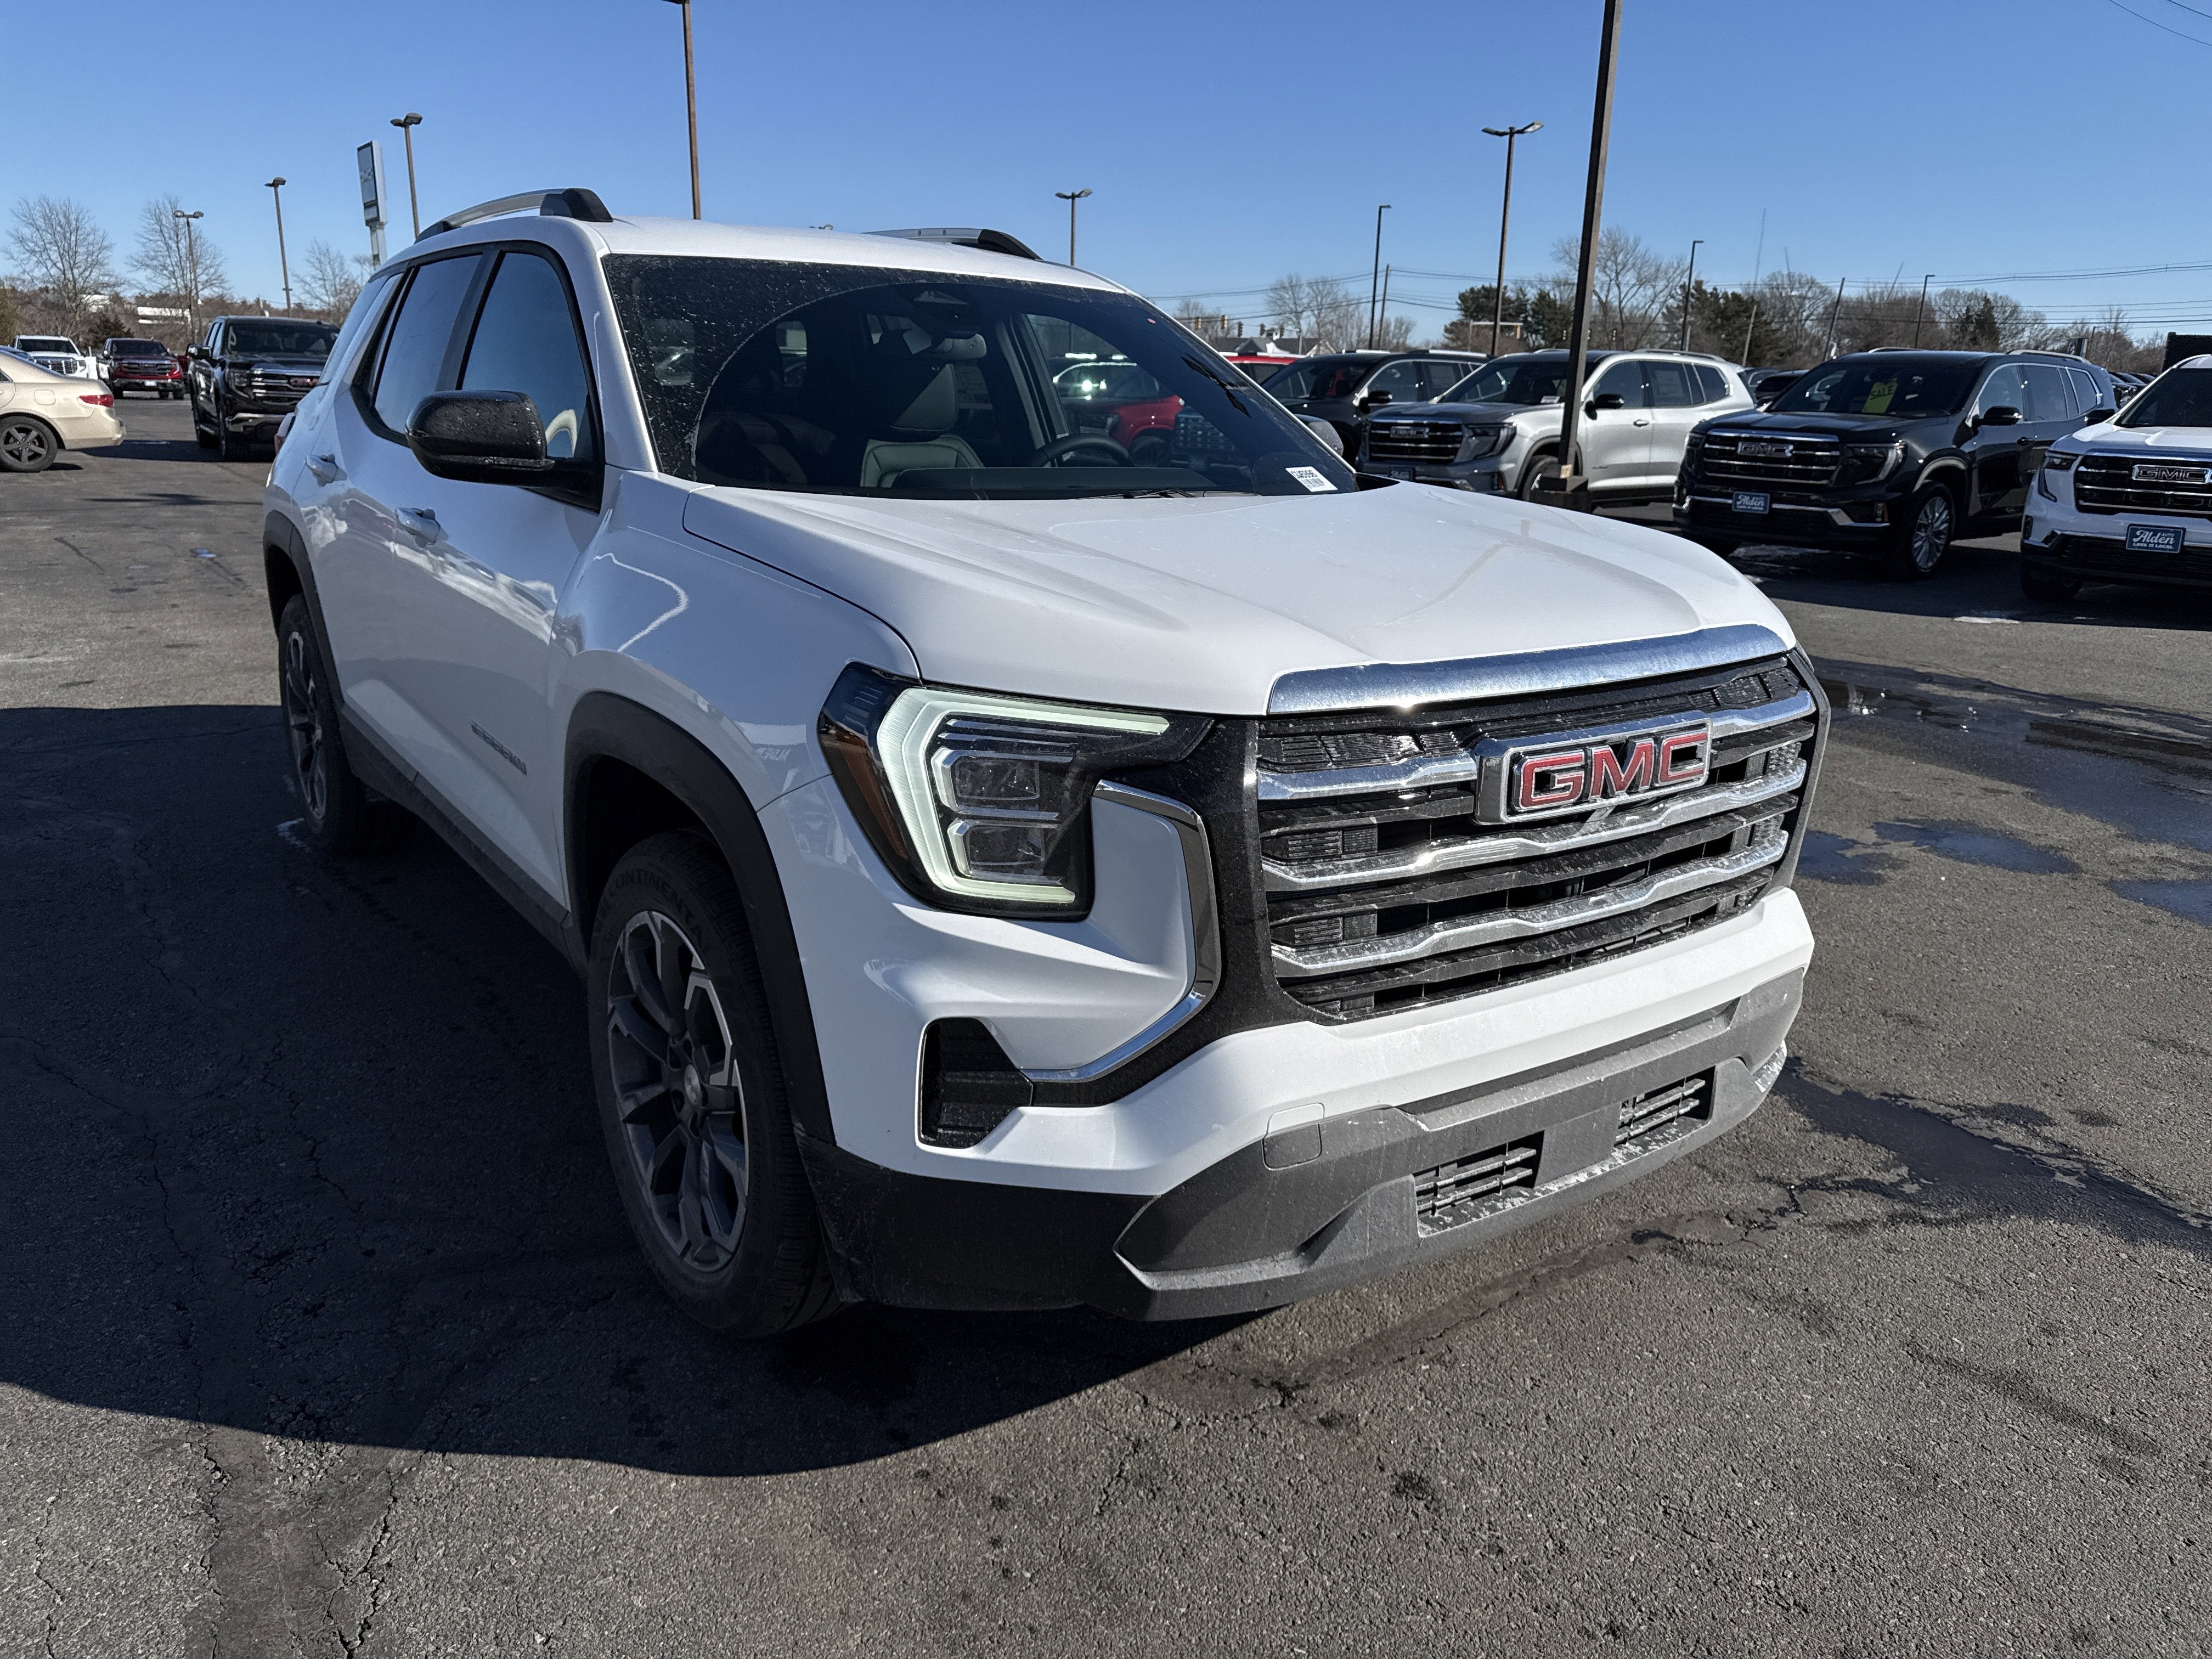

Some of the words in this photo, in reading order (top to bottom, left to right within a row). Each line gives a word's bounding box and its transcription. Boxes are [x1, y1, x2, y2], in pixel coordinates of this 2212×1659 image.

[1869, 385, 1894, 400] SALE
[2137, 467, 2206, 482] GMC
[1736, 494, 1764, 506] Alden
[2133, 530, 2175, 544] Alden
[1517, 729, 1707, 811] GMC
